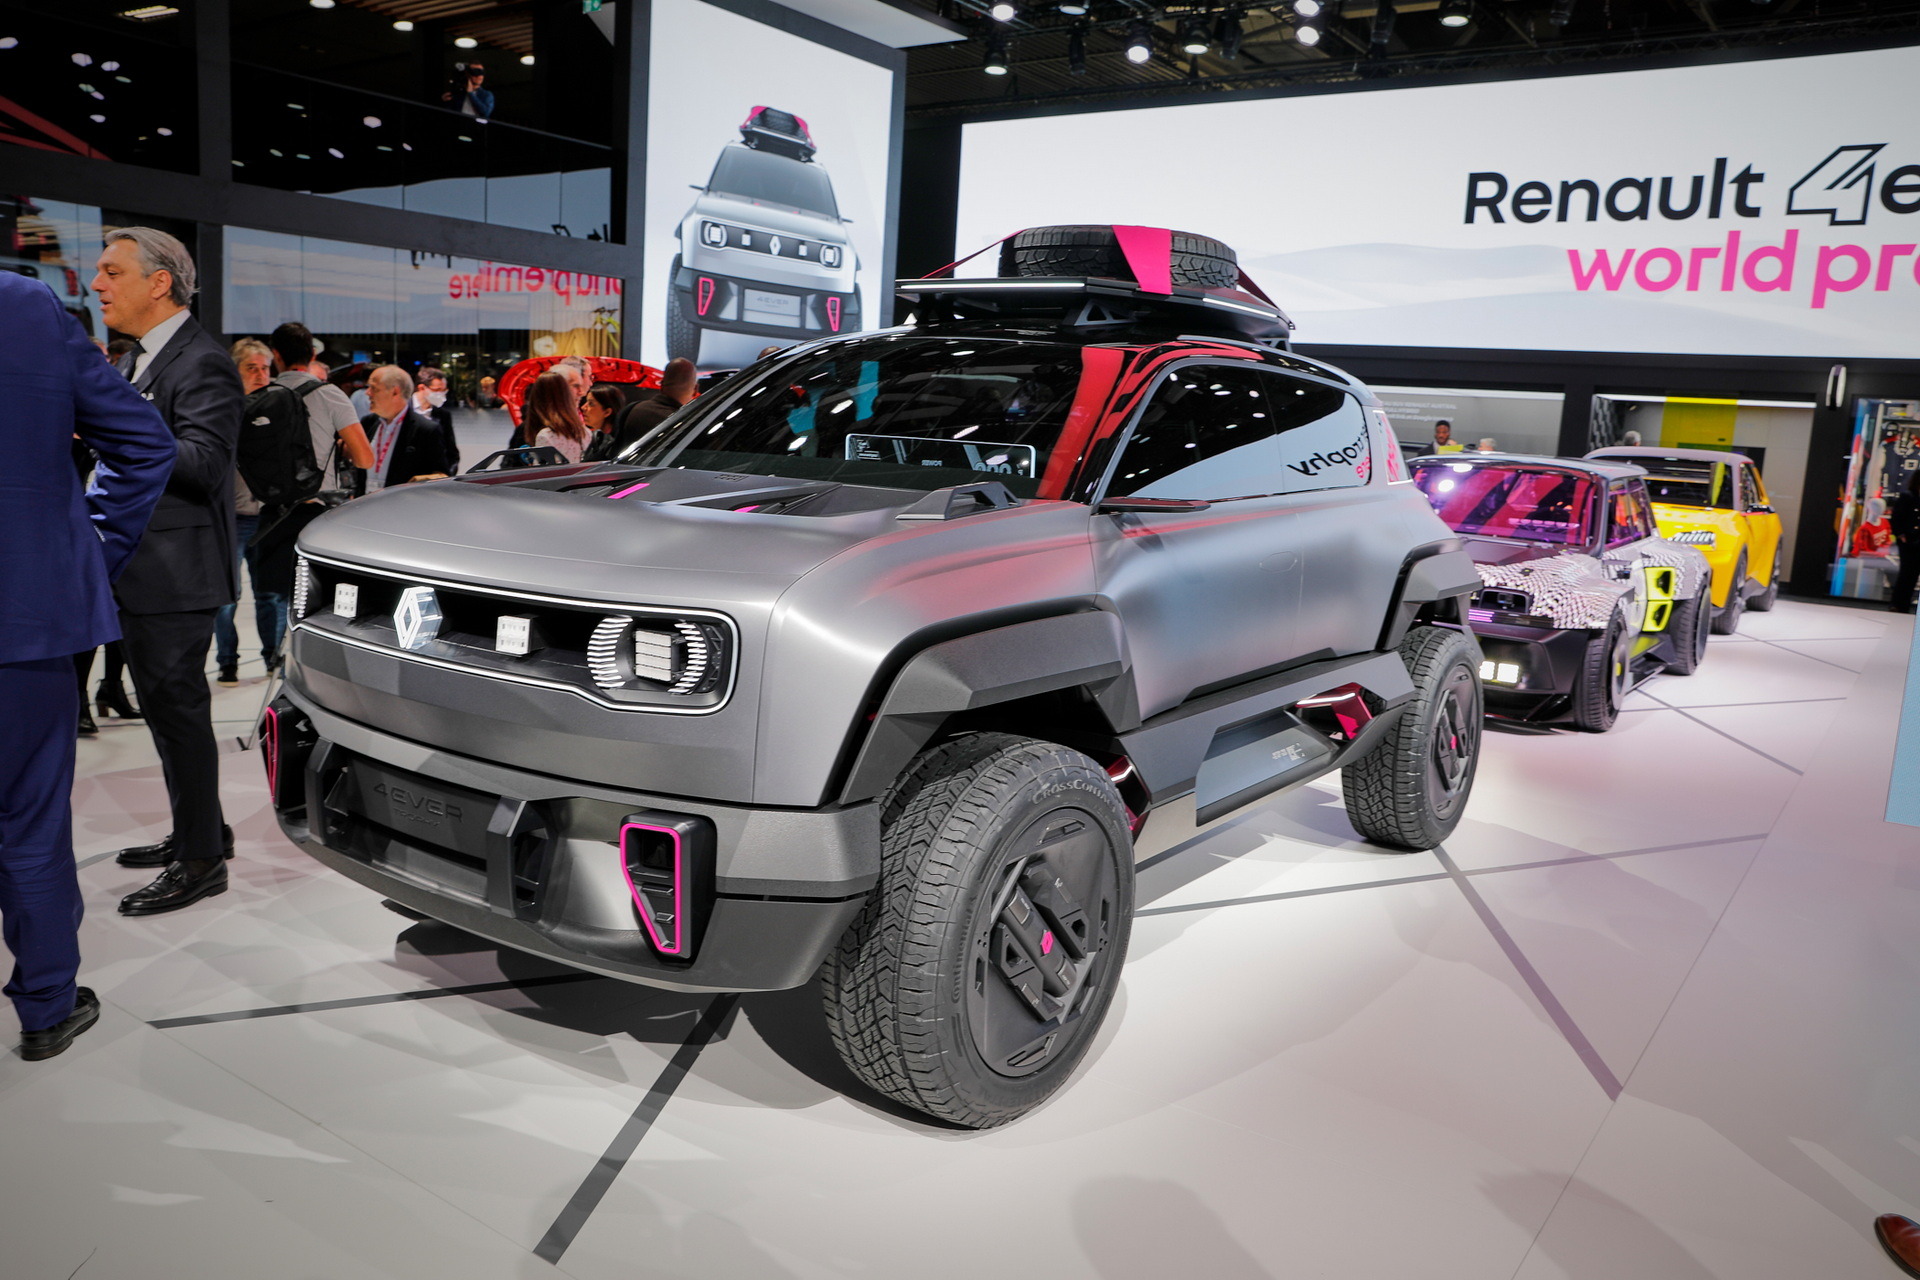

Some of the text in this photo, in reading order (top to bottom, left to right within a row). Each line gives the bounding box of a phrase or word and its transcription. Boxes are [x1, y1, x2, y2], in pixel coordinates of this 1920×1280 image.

[1464, 157, 1766, 225] Renault
[1567, 229, 1920, 309] world pr
[374, 783, 463, 822] 4EVER
